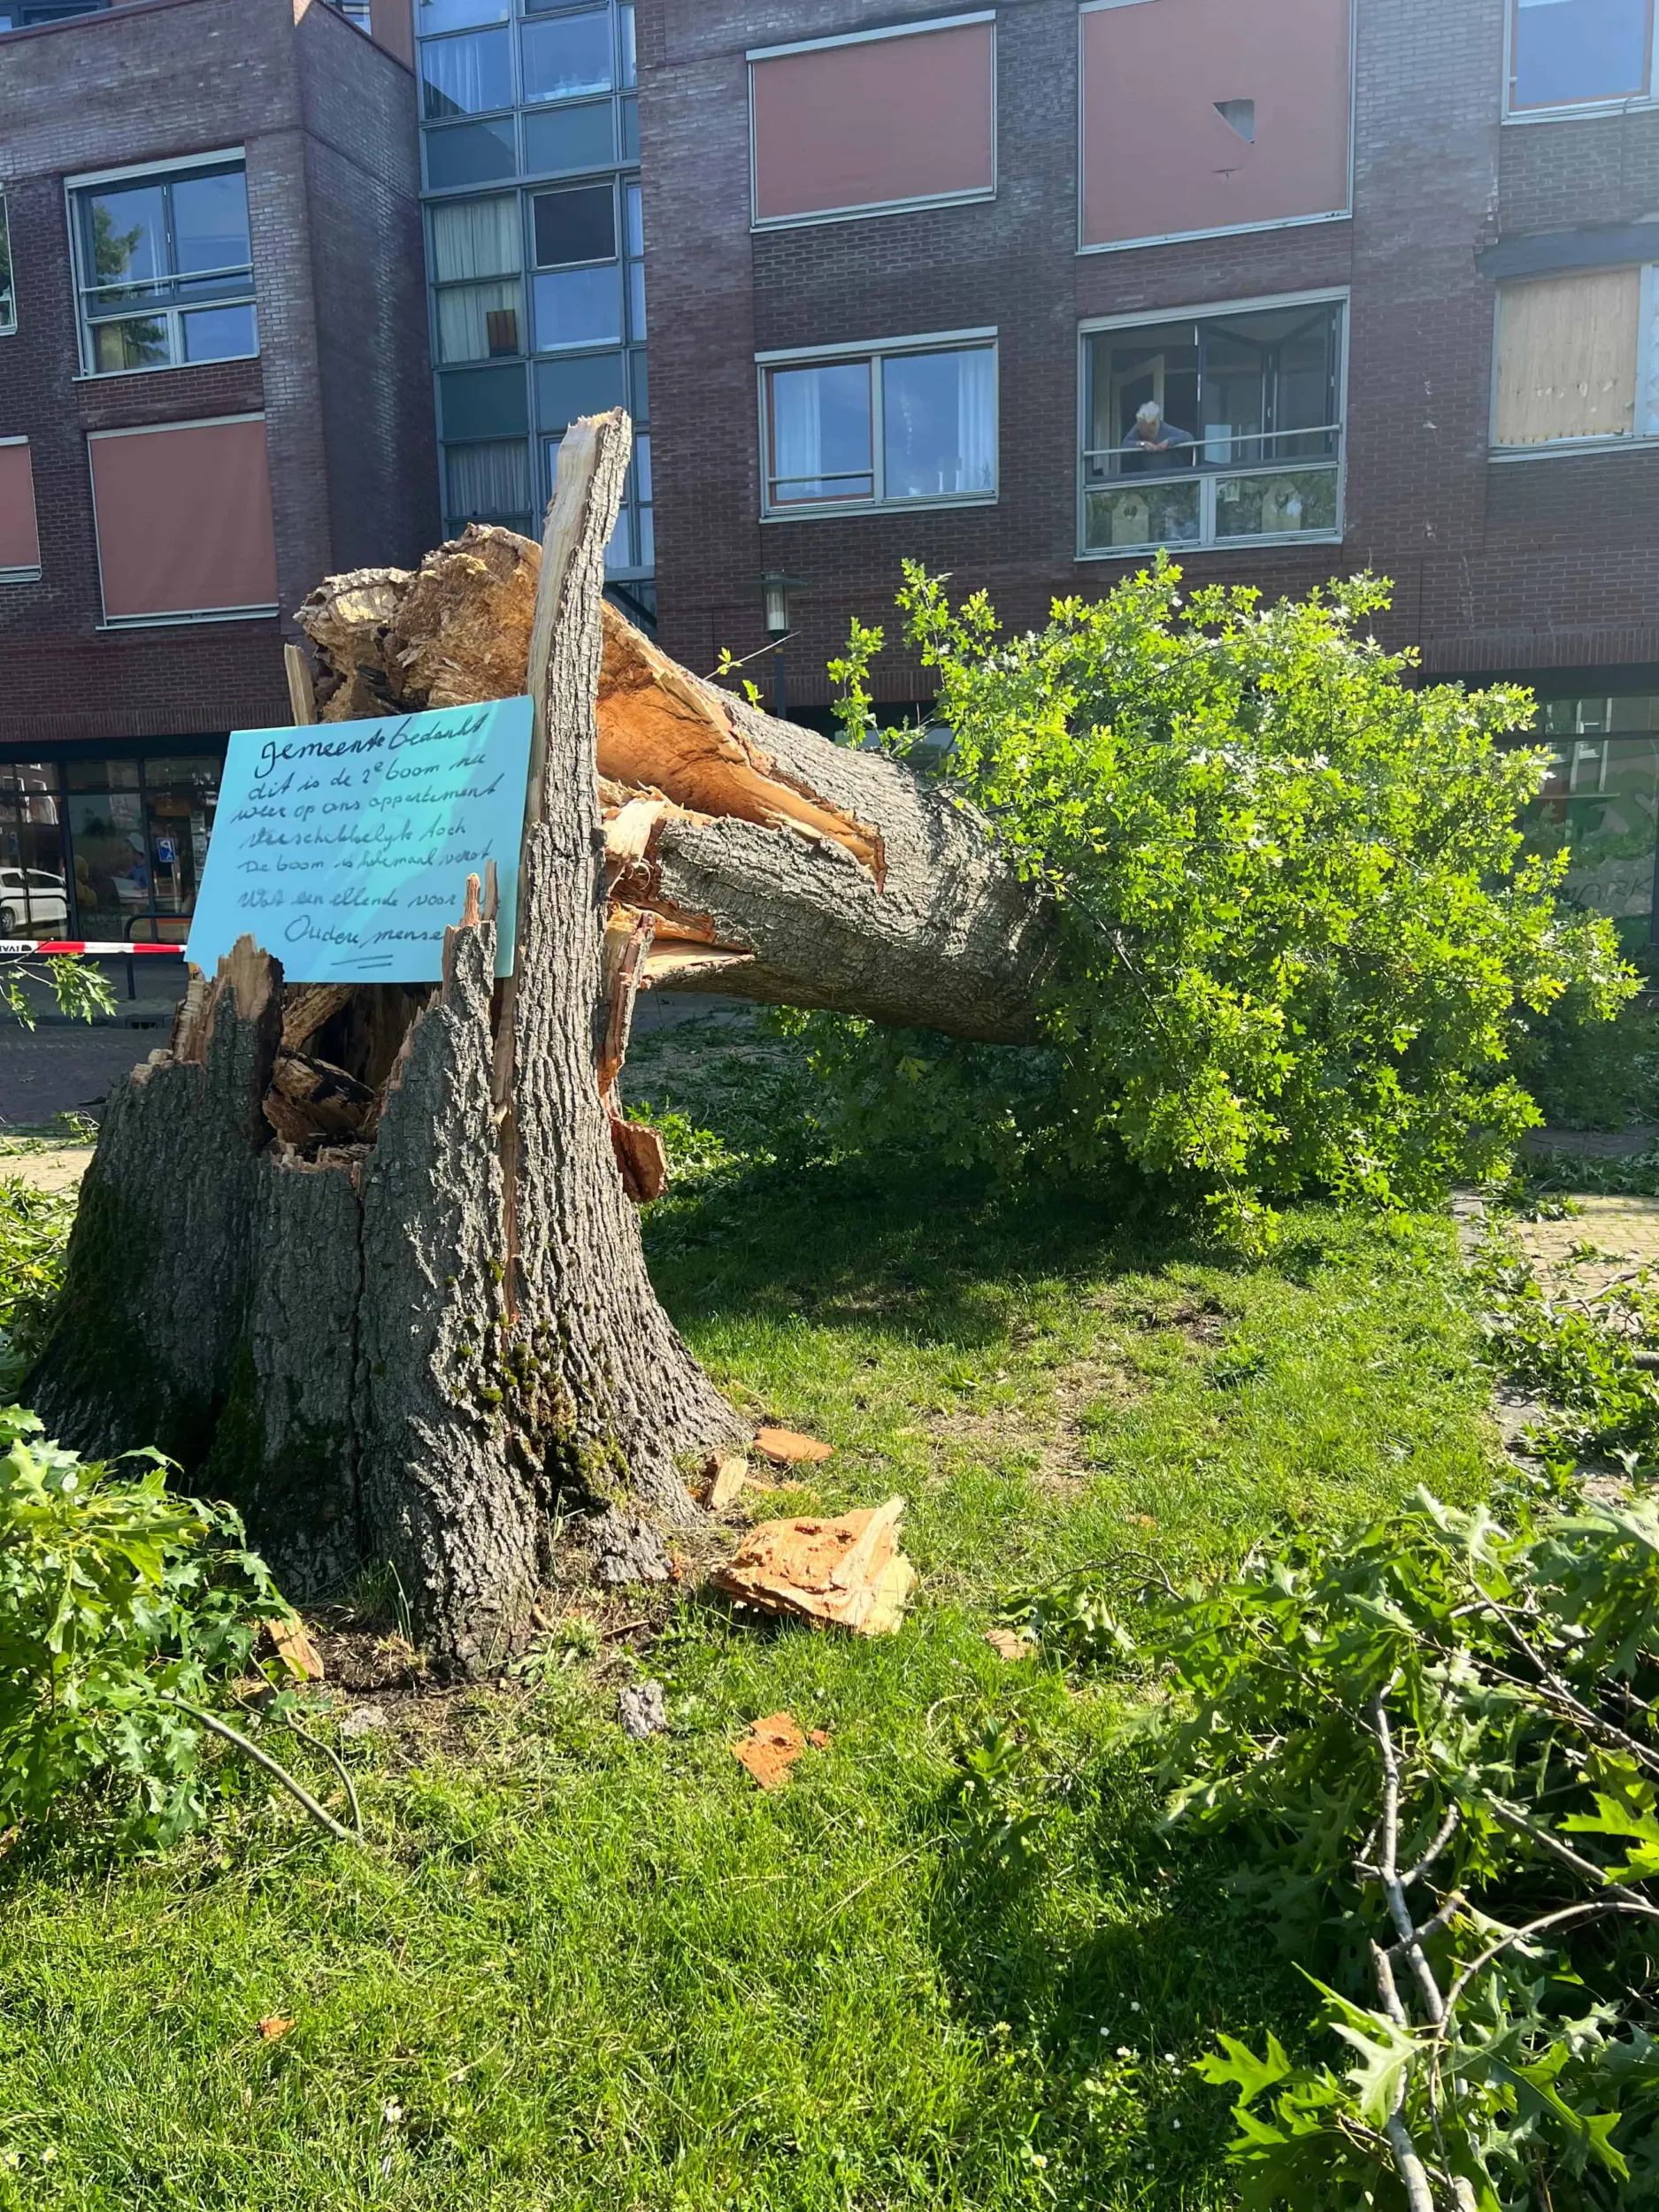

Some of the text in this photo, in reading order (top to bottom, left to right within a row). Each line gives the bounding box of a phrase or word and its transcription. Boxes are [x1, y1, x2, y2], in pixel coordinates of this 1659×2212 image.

[248, 772, 296, 801] dit
[297, 775, 320, 793] is
[330, 768, 352, 787] de
[385, 757, 440, 780] boom
[293, 804, 316, 822] op
[322, 800, 361, 815] ons
[276, 854, 325, 872] boom
[407, 893, 457, 909] voor
[357, 927, 445, 949] mense
